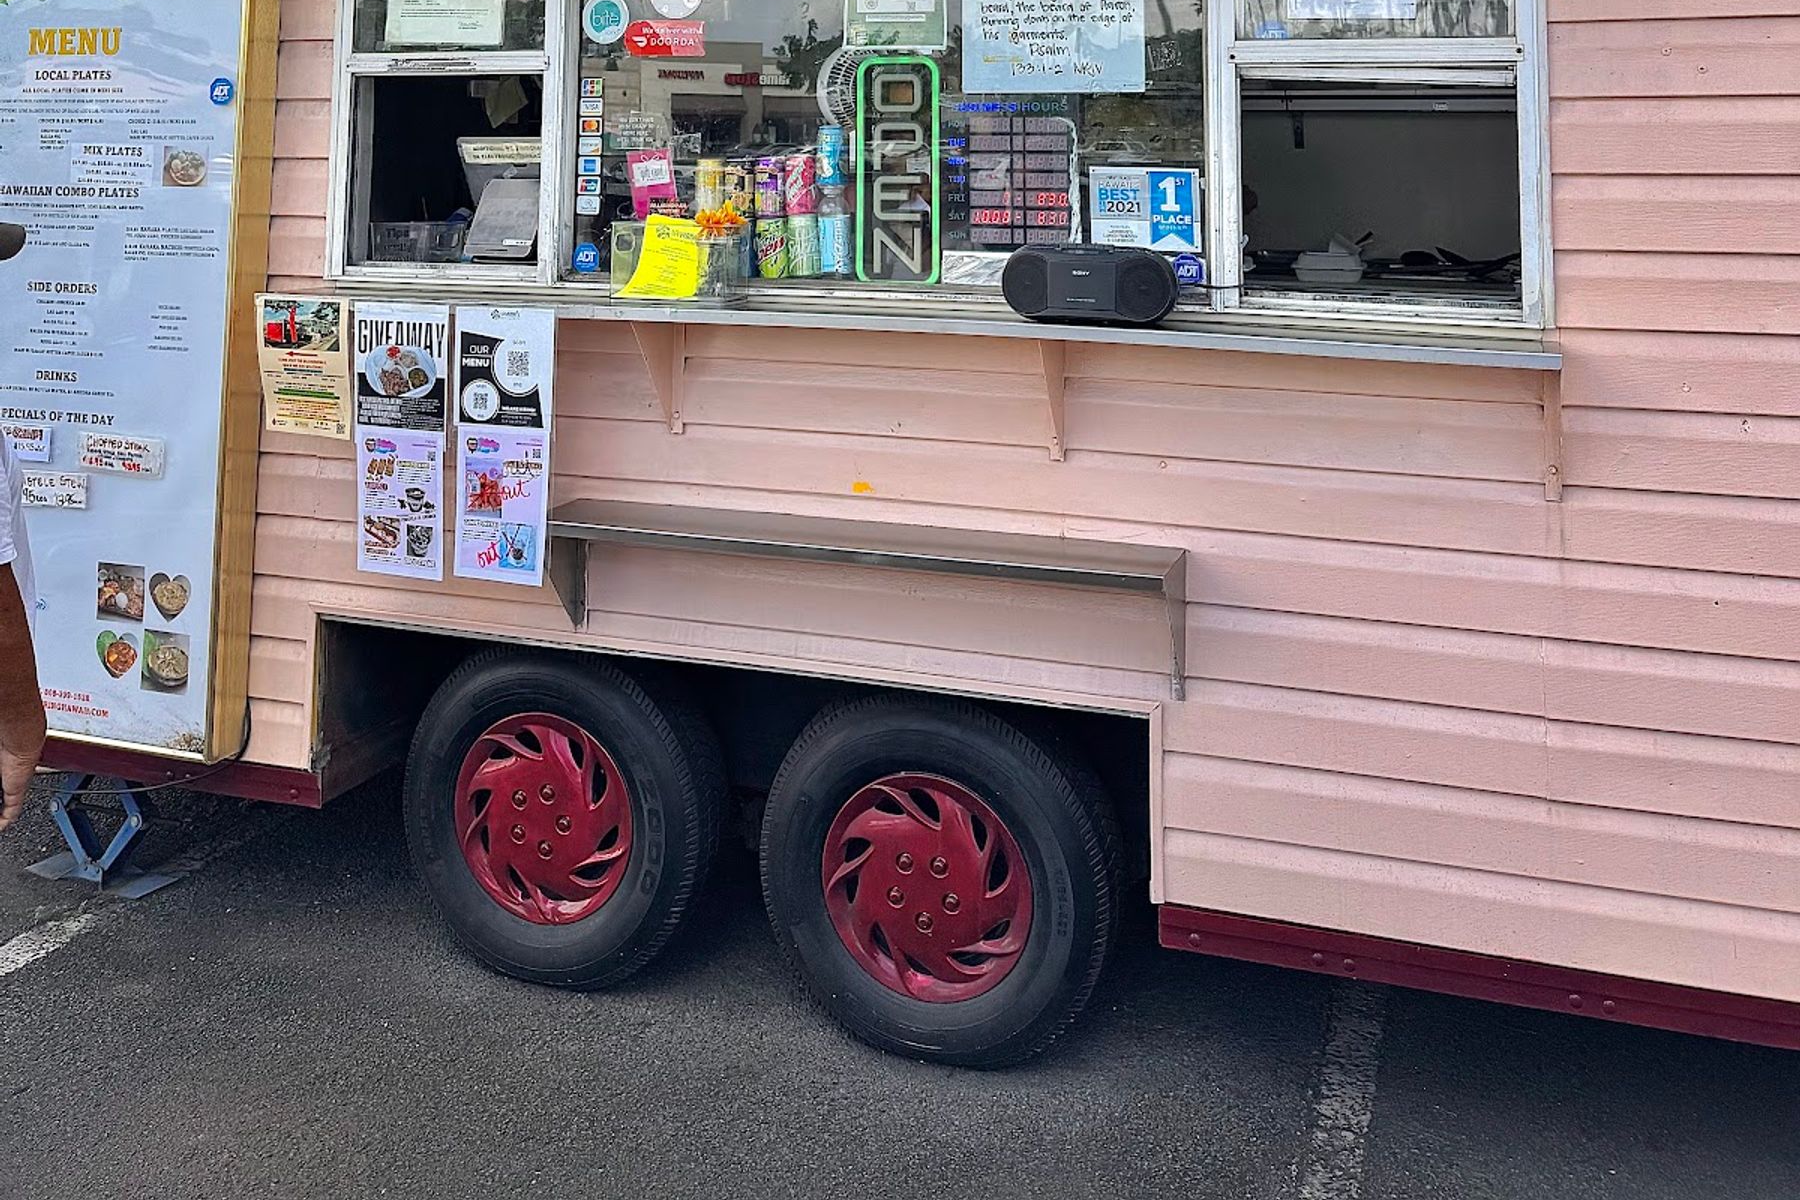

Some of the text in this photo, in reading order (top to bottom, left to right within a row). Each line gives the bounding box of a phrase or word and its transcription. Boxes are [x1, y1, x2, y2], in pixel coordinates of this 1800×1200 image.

[1015, 1, 1036, 12] the
[592, 7, 620, 27] bite
[1069, 13, 1086, 24] the
[28, 27, 122, 56] MENU
[35, 70, 112, 81] LOCAL PLATES
[1022, 101, 1068, 112] HOURS
[947, 138, 966, 147] TUE
[83, 145, 143, 157] MIX PLATES
[873, 73, 923, 274] OPEN
[0, 184, 140, 199] HAWAIIAN COMBO PLATES
[948, 193, 966, 202] FRI
[1099, 188, 1140, 201] BEST
[1107, 201, 1141, 213] 2021
[948, 212, 966, 220] SAT
[1153, 214, 1192, 225] PLACE
[576, 251, 597, 263] ADT
[1177, 265, 1200, 278] ADT
[27, 281, 97, 294] SIDE ORDERS
[358, 319, 445, 358] GIVEAWAY
[469, 345, 490, 354] OUR
[462, 357, 490, 367] MENU
[36, 370, 78, 382] DRINKS
[1, 407, 115, 426] PECIALS OF THE DAY
